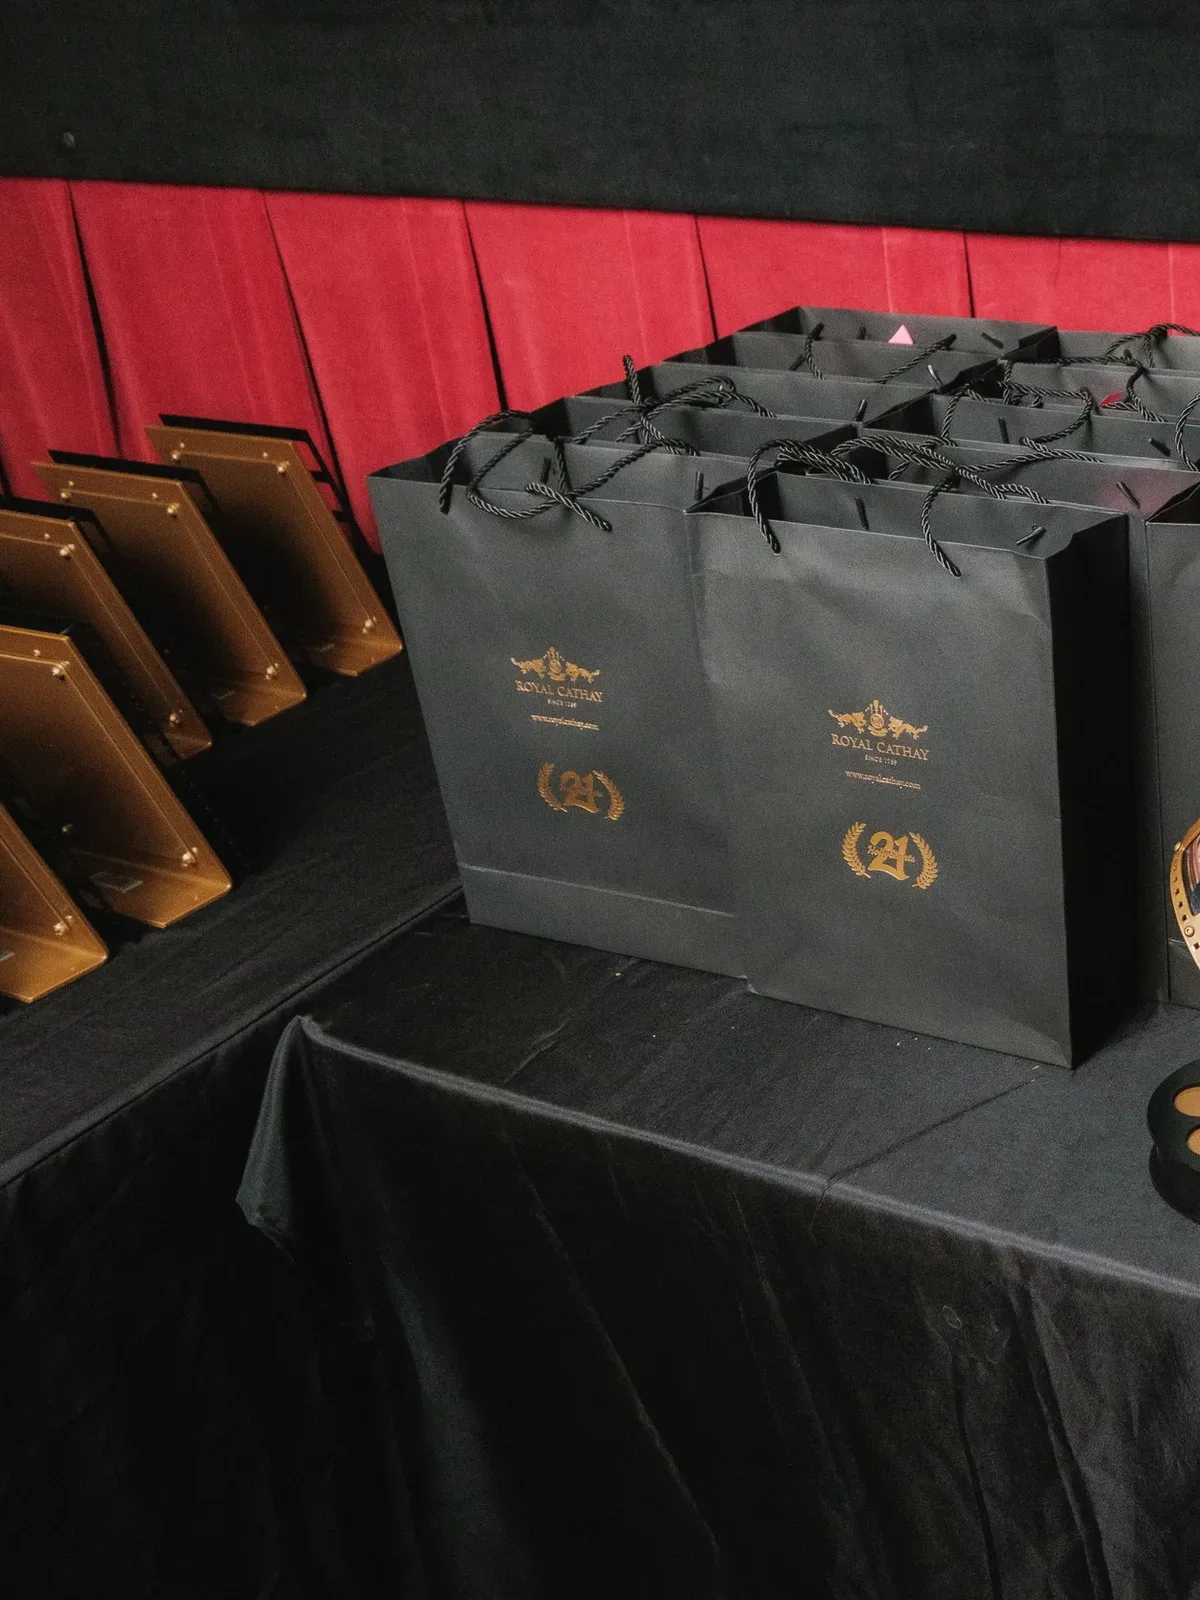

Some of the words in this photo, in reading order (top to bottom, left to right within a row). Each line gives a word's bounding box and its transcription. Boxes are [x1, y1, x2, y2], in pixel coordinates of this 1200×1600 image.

[515, 680, 554, 694] ROYAL
[557, 686, 603, 702] CATHAY
[830, 733, 873, 750] ROYAL
[877, 742, 929, 760] CATHAY
